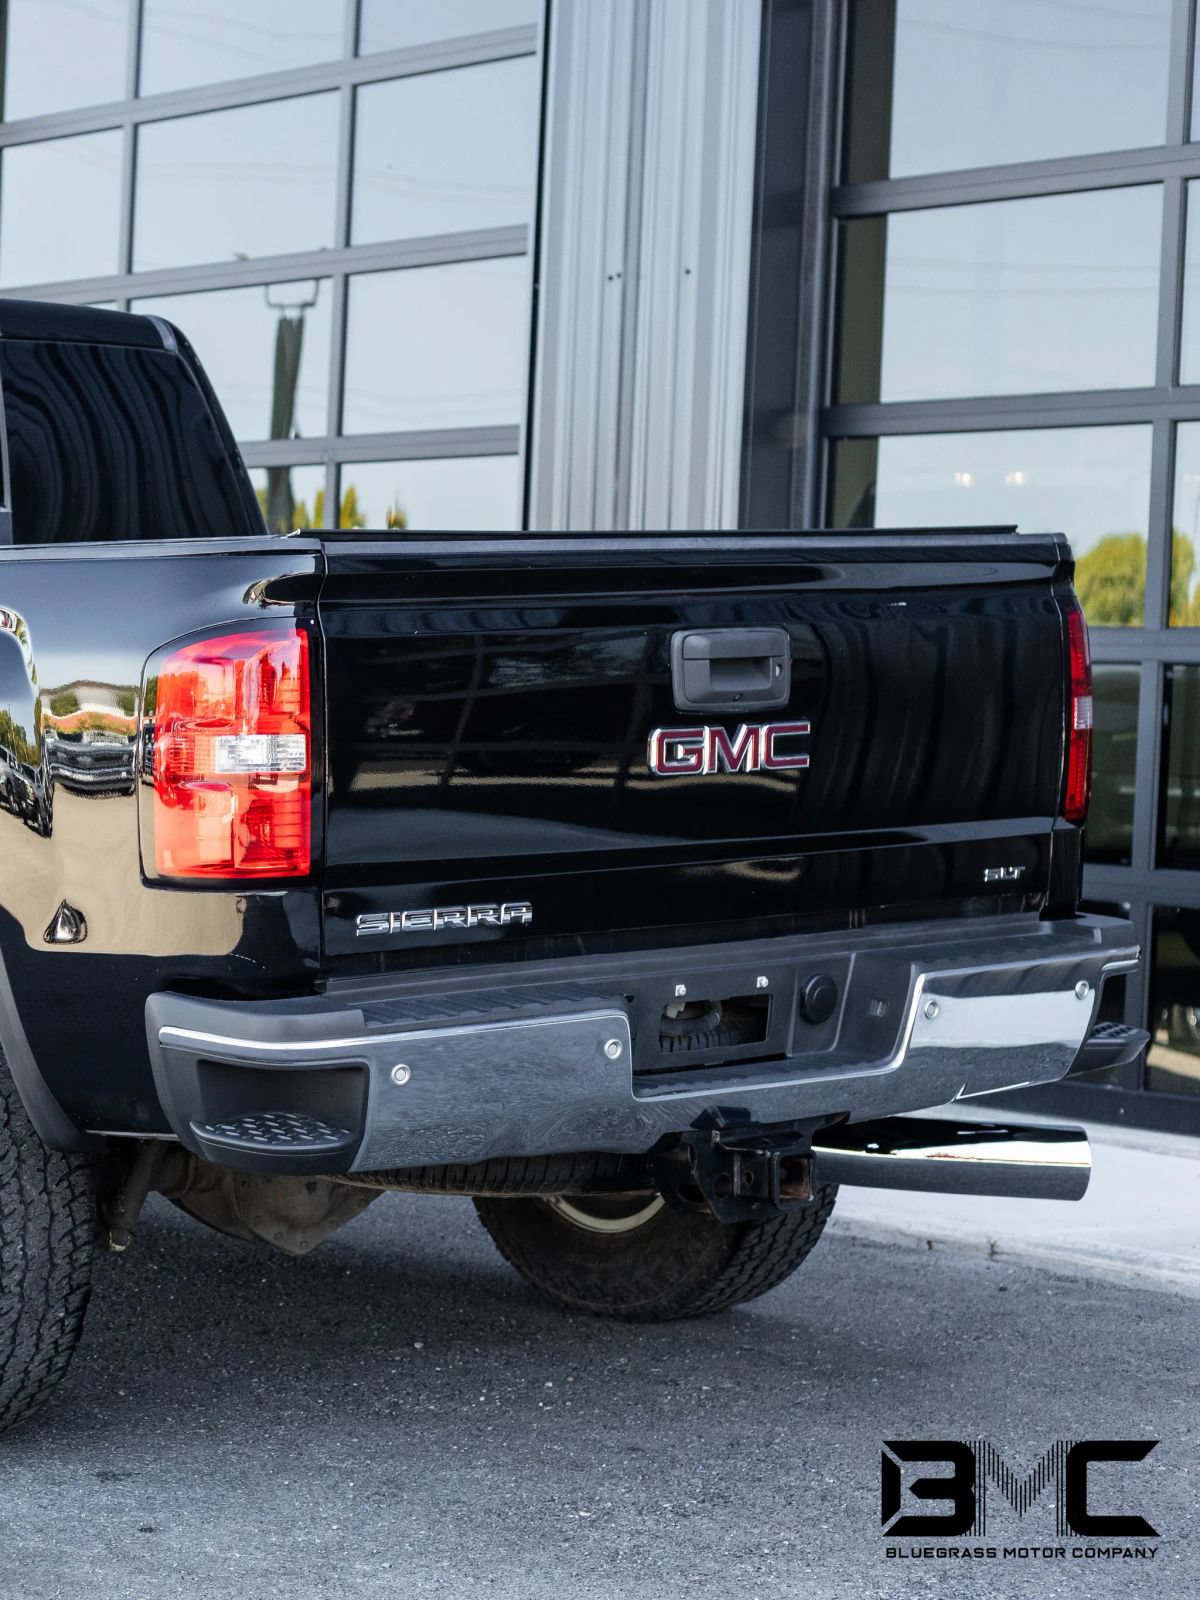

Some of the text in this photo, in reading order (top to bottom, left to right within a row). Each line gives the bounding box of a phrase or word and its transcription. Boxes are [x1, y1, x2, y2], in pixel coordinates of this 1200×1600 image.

[647, 720, 811, 776] GMC
[984, 866, 1026, 882] SLT
[356, 901, 533, 937] SIERRA
